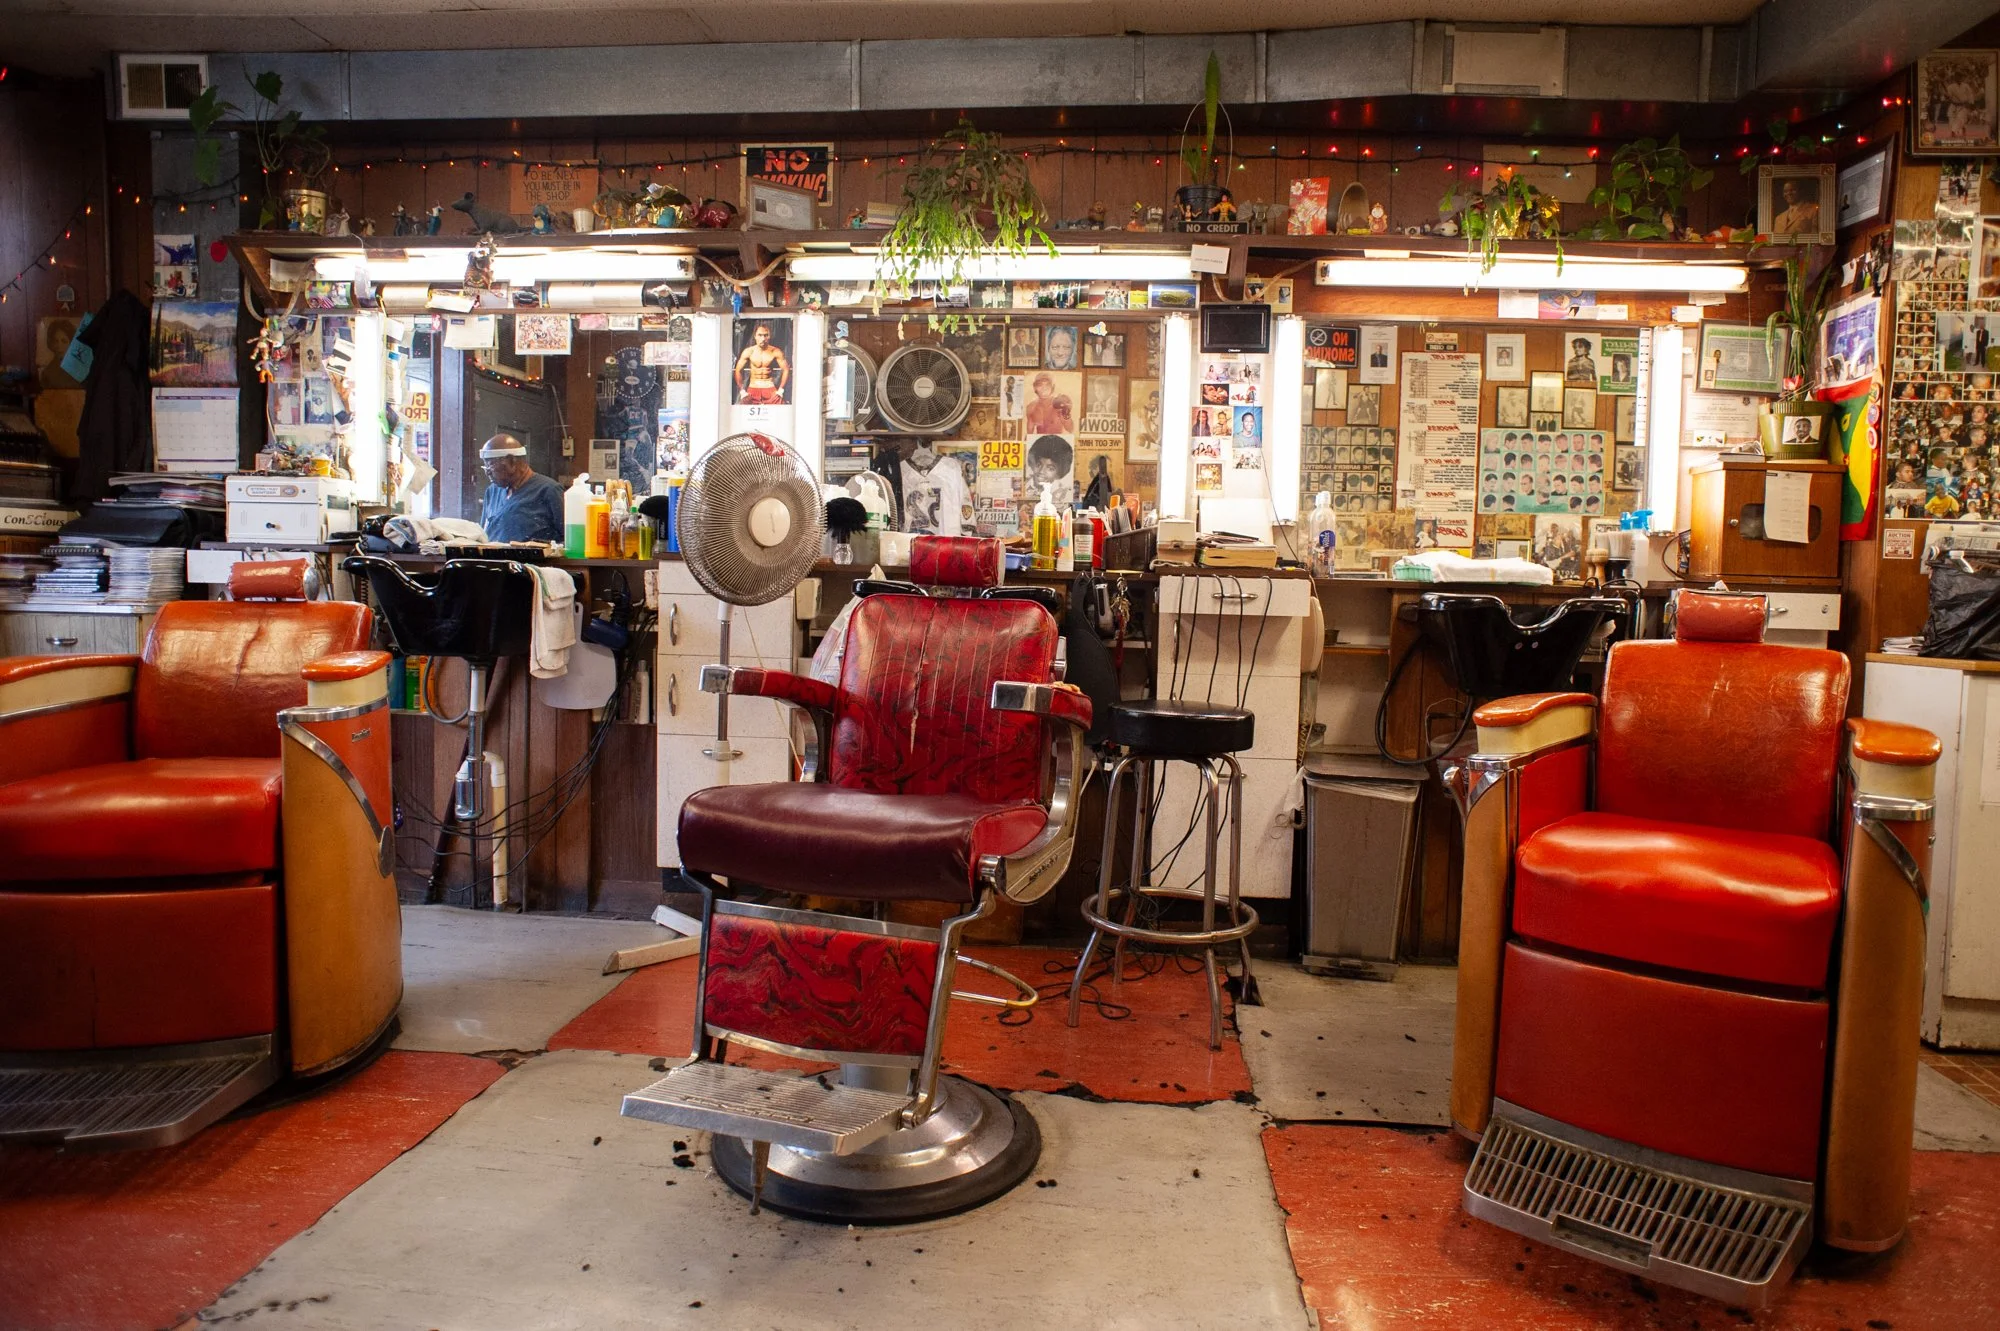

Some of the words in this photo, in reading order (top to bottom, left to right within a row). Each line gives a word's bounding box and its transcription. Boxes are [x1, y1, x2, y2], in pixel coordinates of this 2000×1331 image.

[764, 150, 809, 172] NO
[541, 171, 552, 180] BE
[557, 170, 580, 180] NEXT
[523, 181, 540, 191] YOU
[542, 181, 560, 191] MUST
[564, 181, 572, 191] BE
[574, 181, 581, 191] IN
[523, 191, 541, 201] THE
[546, 191, 570, 201] SHOP
[1186, 223, 1201, 233] NO
[1206, 223, 1240, 233] CREDIT
